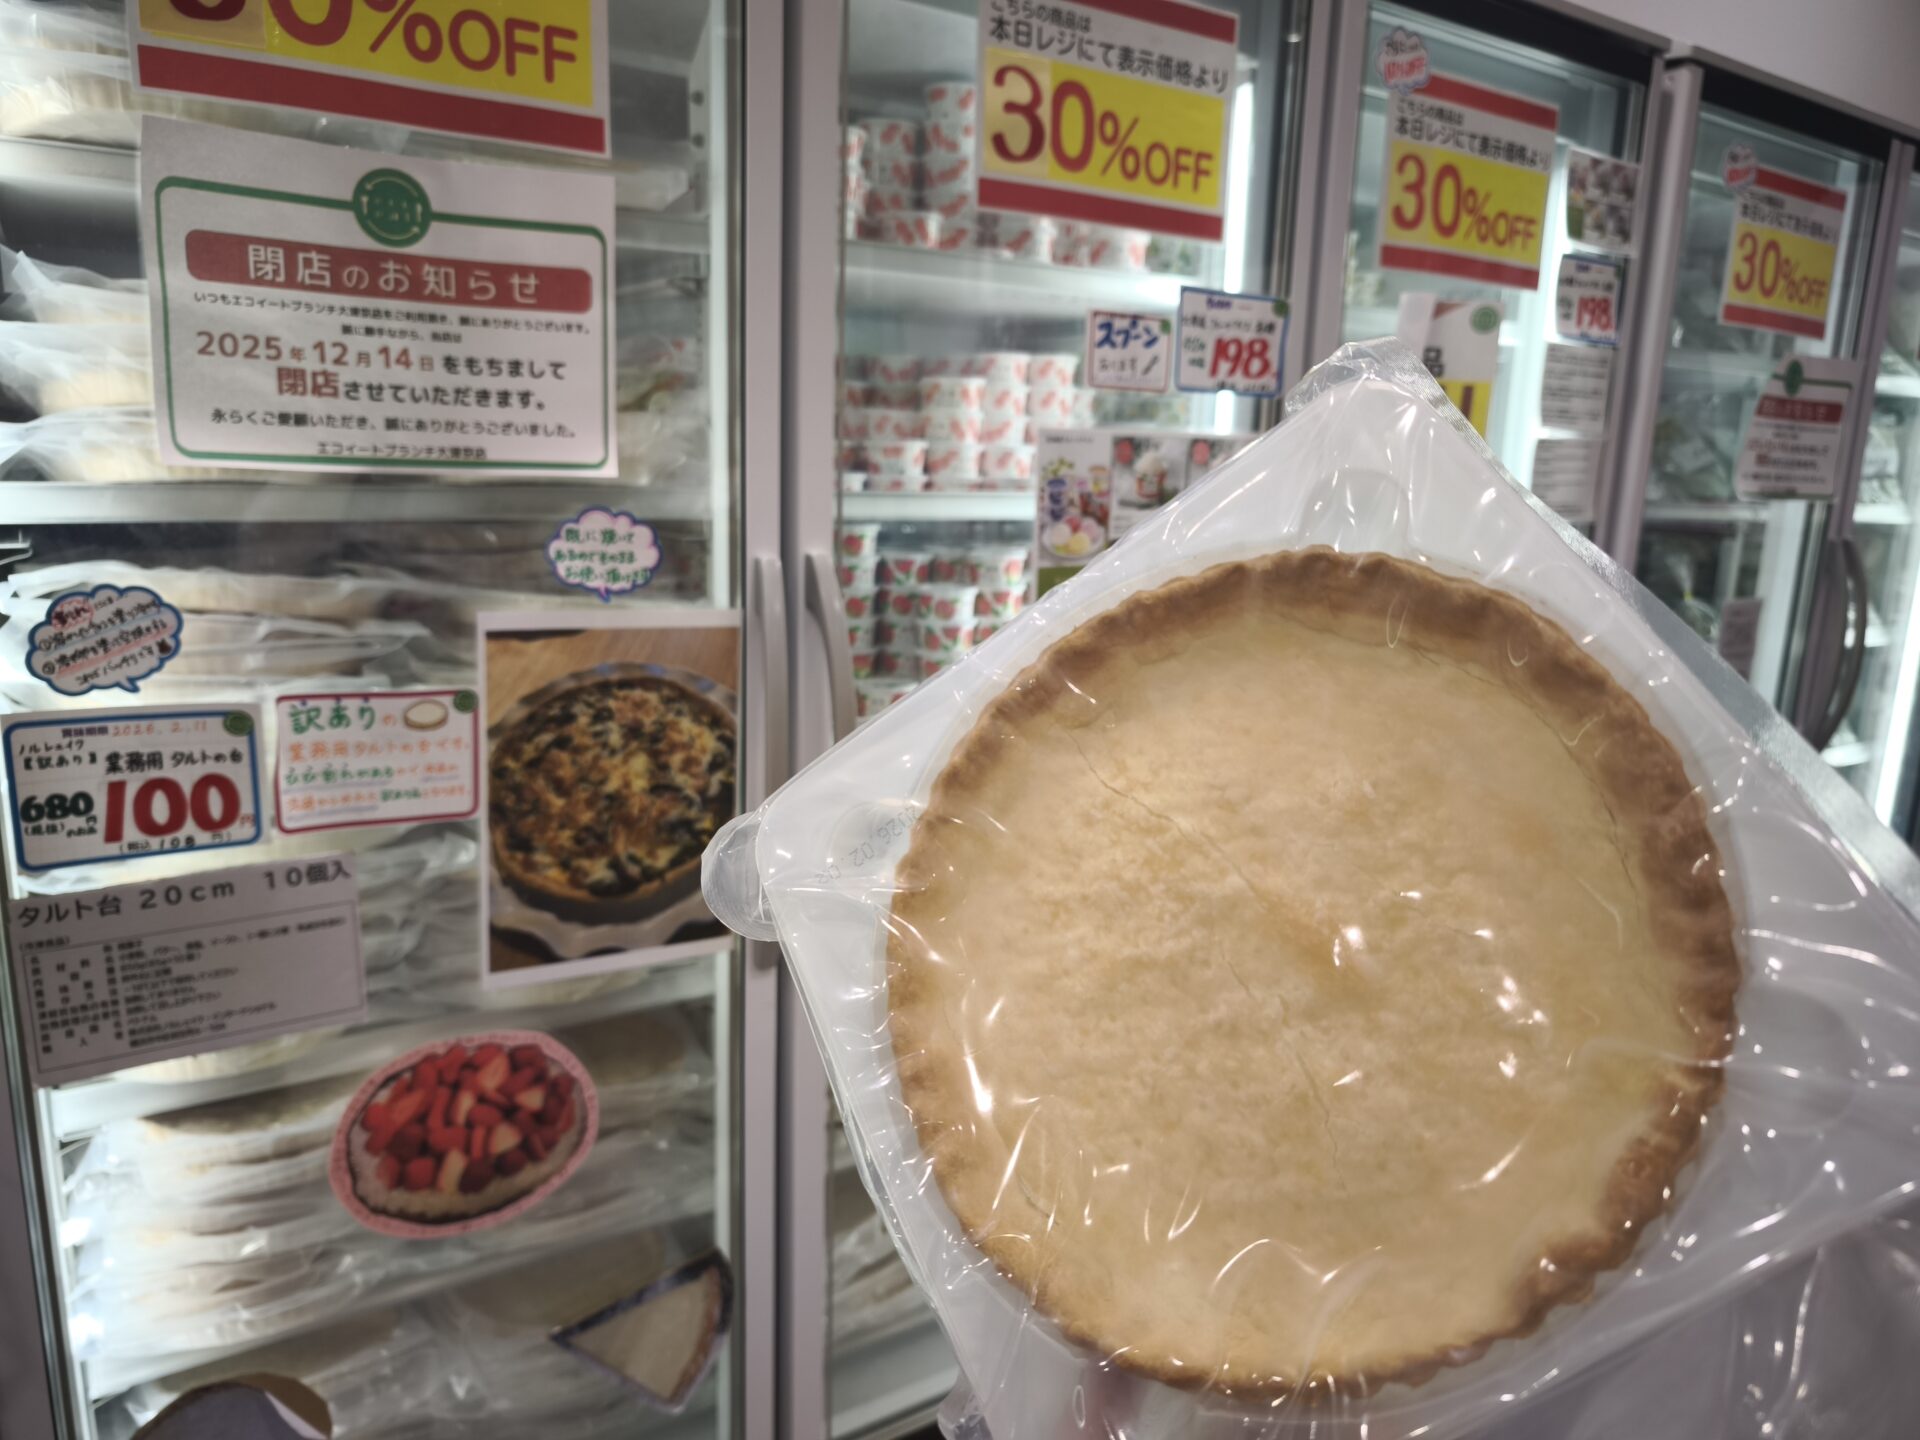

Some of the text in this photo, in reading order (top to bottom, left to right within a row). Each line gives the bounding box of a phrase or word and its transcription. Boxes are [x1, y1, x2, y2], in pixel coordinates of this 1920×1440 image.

[167, 0, 579, 84] %OFF
[990, 15, 1228, 94] 本日レジにて表示価格より
[991, 64, 1214, 193] 30%OFF
[1391, 152, 1538, 251] 30%OFF
[247, 243, 540, 304] 閉店のお知らせ
[1209, 337, 1271, 380] 198
[276, 365, 546, 411] 閉店させていただきます。
[104, 750, 164, 775] 業務用
[20, 791, 94, 824] 680
[104, 772, 241, 844] 100
[139, 880, 236, 911] 20cm
[263, 859, 352, 890] 10個入
[18, 895, 123, 929] タルト台
